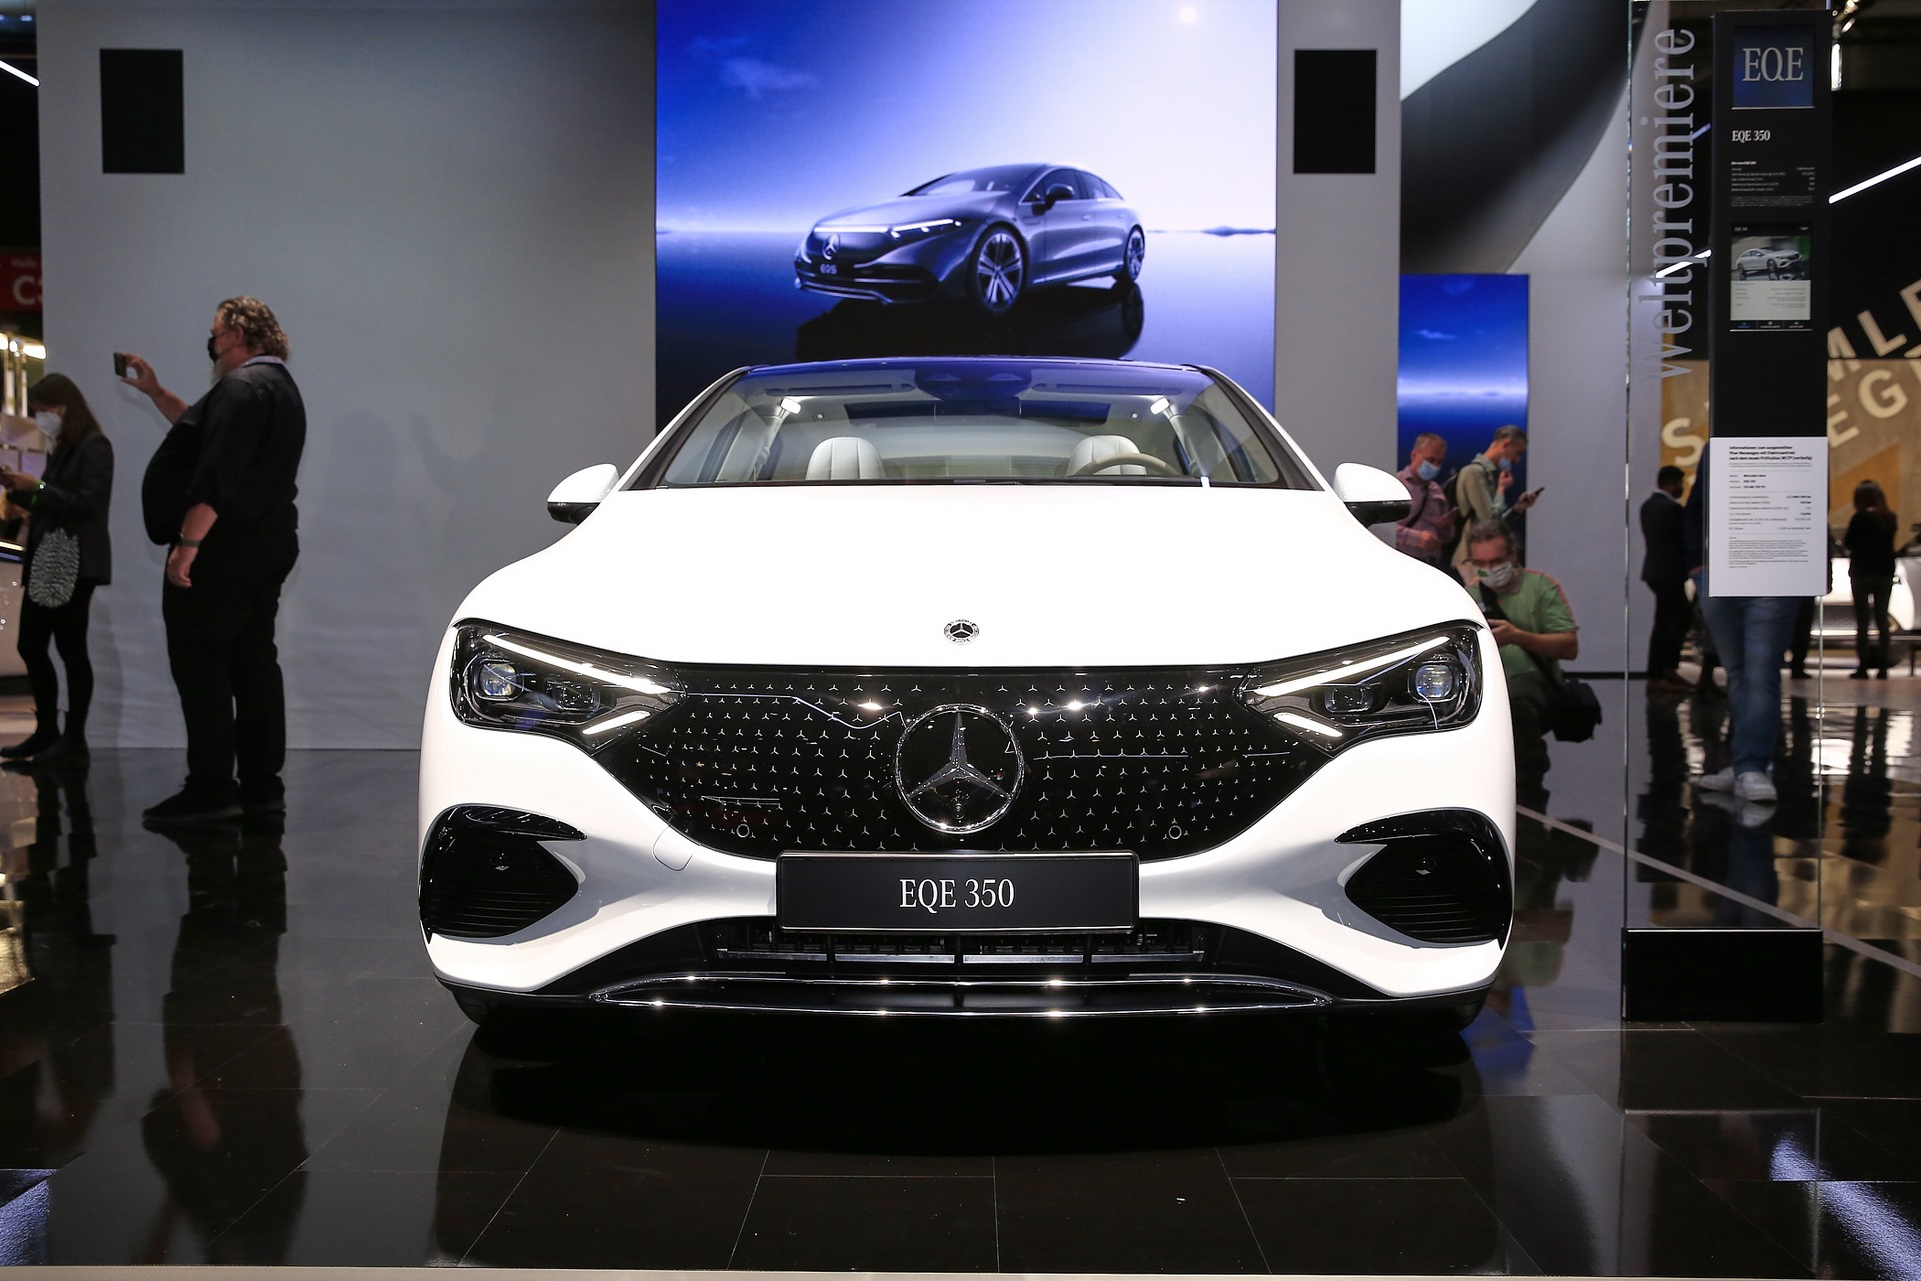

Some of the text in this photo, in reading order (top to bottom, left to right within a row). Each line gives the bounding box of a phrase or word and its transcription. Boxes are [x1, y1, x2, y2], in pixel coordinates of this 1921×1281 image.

[1742, 47, 1804, 82] EQE
[1731, 130, 1771, 143] EQE 350
[12, 274, 42, 306] C
[899, 878, 1015, 914] EQE 350
